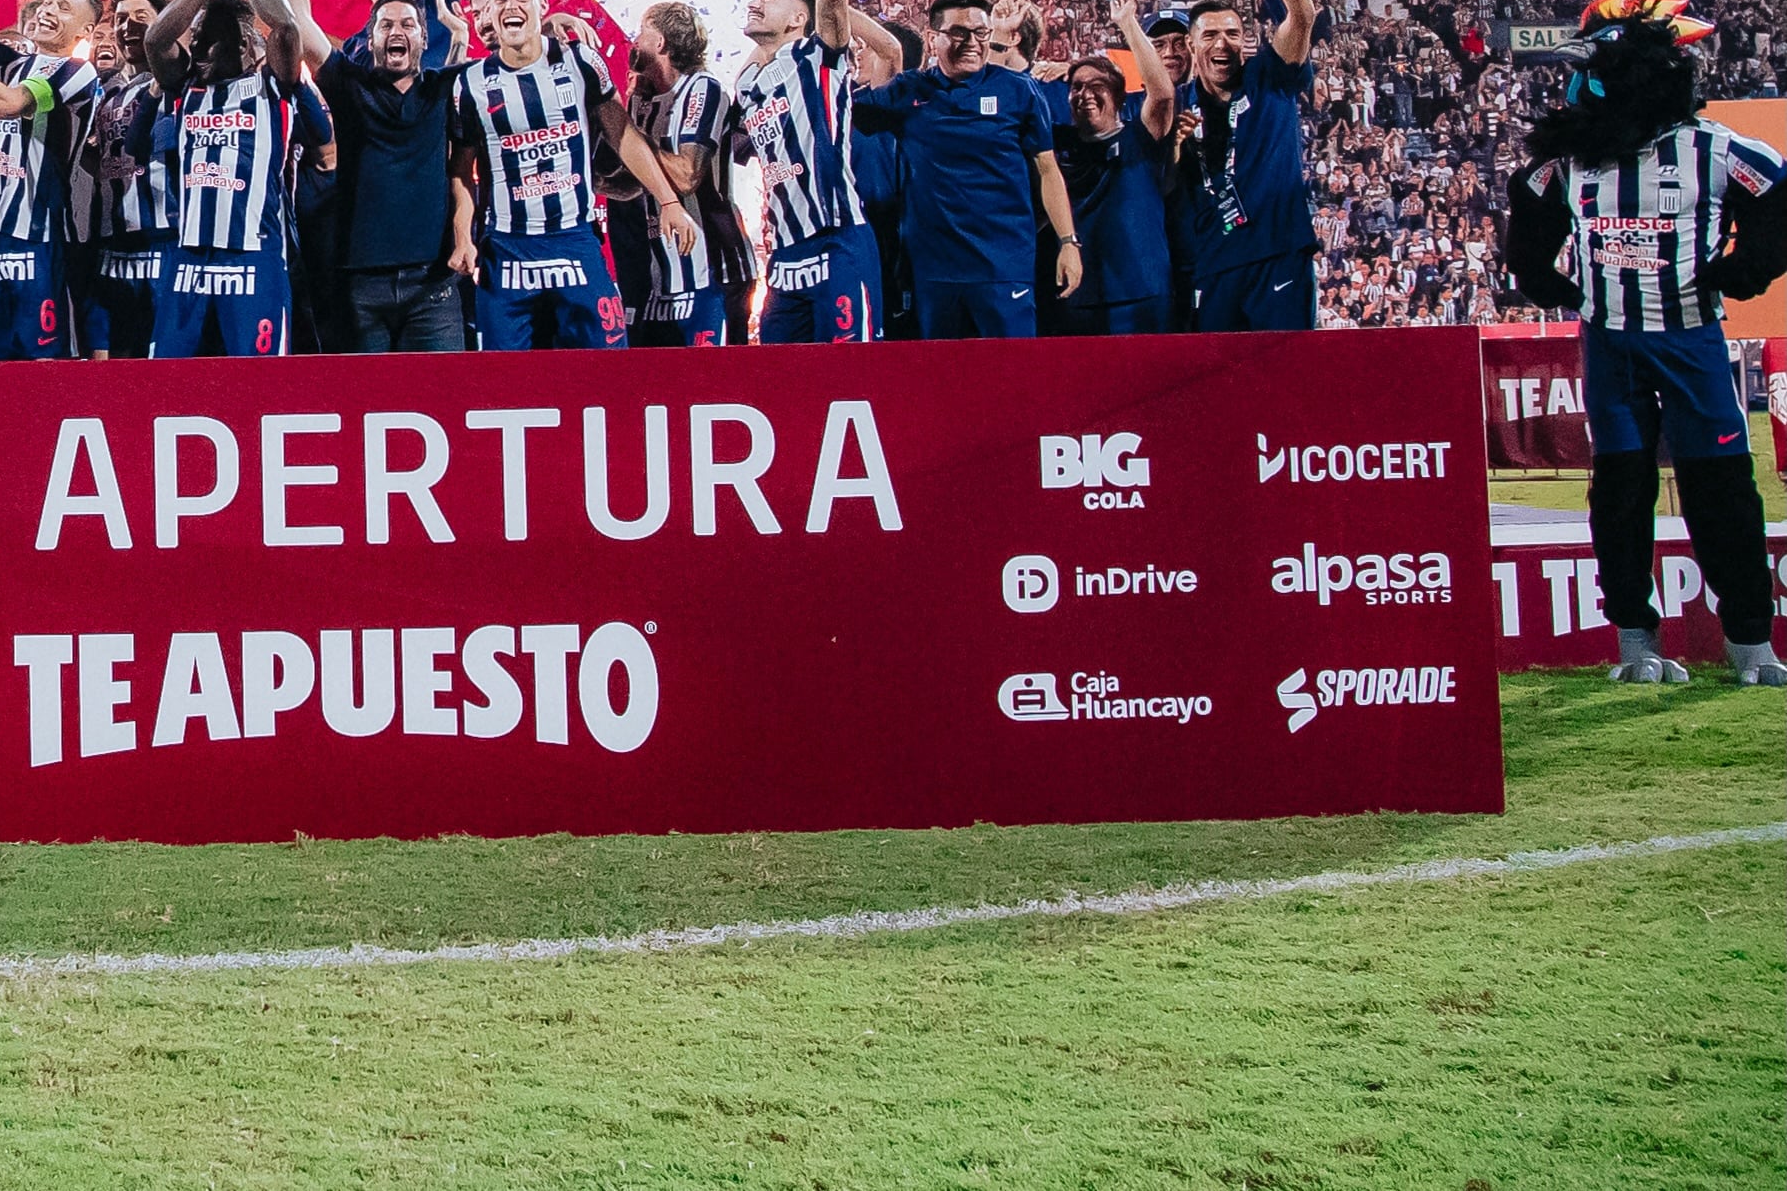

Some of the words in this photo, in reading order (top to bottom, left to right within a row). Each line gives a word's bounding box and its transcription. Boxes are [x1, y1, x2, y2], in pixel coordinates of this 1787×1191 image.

[185, 112, 256, 134] apuesta
[194, 130, 239, 148] total
[501, 120, 581, 152] apuesta
[517, 140, 570, 163] total
[184, 173, 246, 190] Huancayo
[512, 173, 582, 201] Huancayo
[1590, 217, 1675, 233] apuesta
[501, 258, 588, 291] ilumi
[768, 253, 830, 291] ilumi
[1593, 249, 1669, 271] Huancayo
[173, 262, 256, 296] ilumi
[39, 299, 56, 333] 6
[597, 295, 625, 332] 99
[835, 295, 854, 330] 3
[255, 318, 274, 355] 8
[34, 400, 904, 551] APERTURA
[1040, 431, 1151, 489] BIG
[1083, 491, 1146, 511] COLA
[1075, 564, 1198, 597] inDrive
[1271, 542, 1452, 606] alpasa
[1365, 589, 1453, 605] SPORTS
[1071, 671, 1120, 699] Caja
[1316, 666, 1456, 708] SPORADE
[1071, 694, 1213, 725] Huancayo
